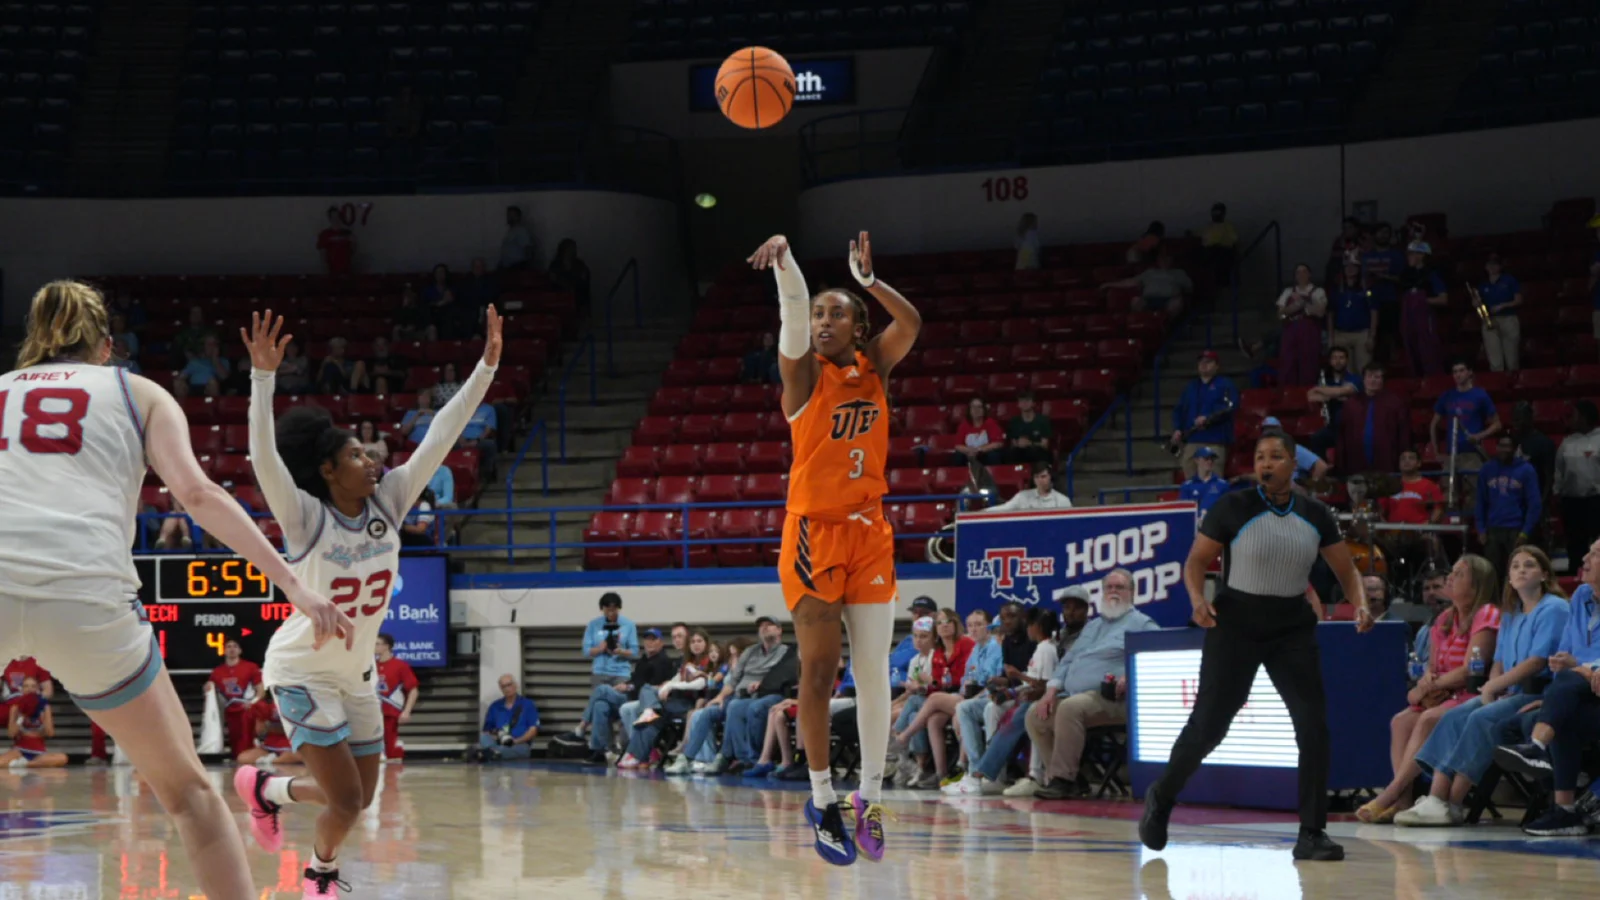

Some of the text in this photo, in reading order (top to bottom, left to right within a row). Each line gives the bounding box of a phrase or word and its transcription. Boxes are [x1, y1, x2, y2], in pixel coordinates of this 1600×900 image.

[981, 176, 1028, 202] 108
[340, 202, 374, 227] 07
[13, 371, 77, 382] AIREY
[831, 398, 880, 441] UTEP
[848, 447, 865, 479] 3
[1065, 521, 1168, 578] HOOP
[330, 569, 393, 619] 23
[1052, 561, 1181, 623] ROP
[142, 604, 178, 621] TECH
[194, 614, 236, 626] PERIOD
[399, 603, 439, 620] Bank
[206, 632, 225, 656] 4
[409, 642, 434, 650] BANK
